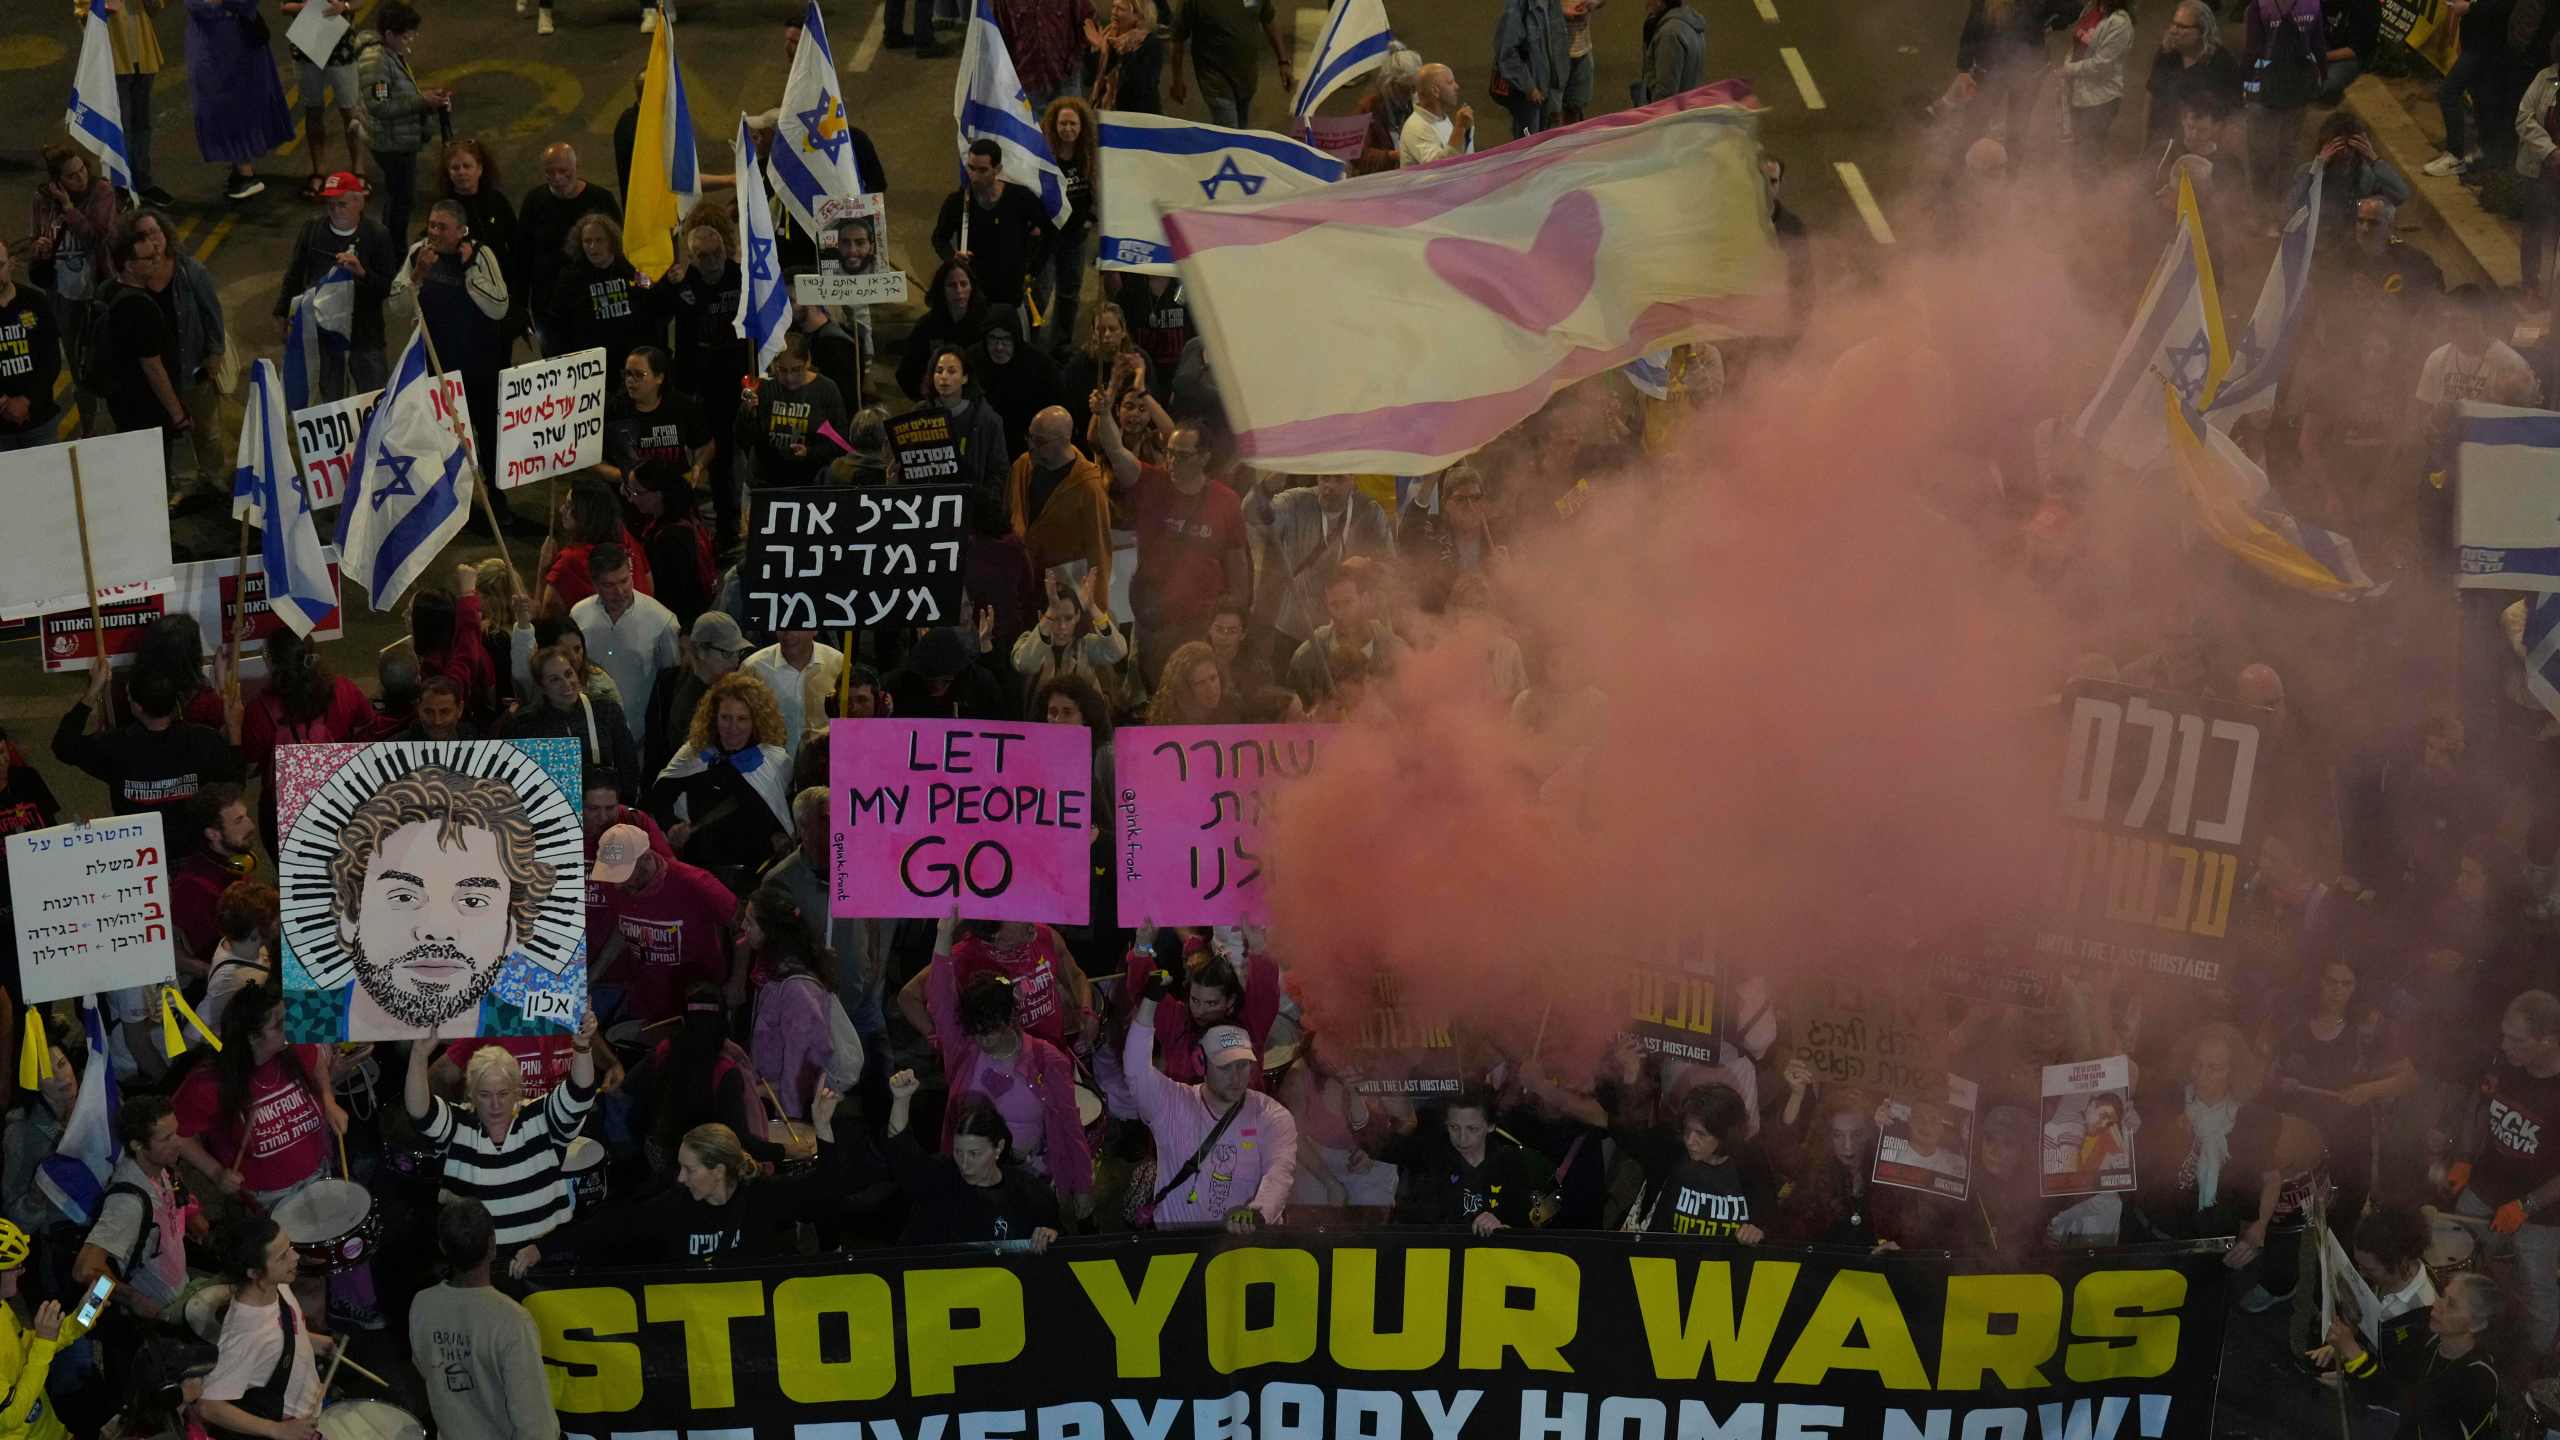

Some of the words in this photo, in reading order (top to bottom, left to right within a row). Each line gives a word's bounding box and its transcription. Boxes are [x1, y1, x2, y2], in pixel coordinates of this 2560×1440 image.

[0, 338, 30, 356] עדיי
[537, 369, 562, 394] יהיה
[568, 359, 604, 382] בסוף
[505, 377, 533, 401] טוב
[578, 391, 602, 413] אם
[772, 400, 788, 415] הם
[789, 402, 812, 418] למה
[532, 427, 567, 450] שזה
[573, 417, 602, 442] סימן
[896, 428, 949, 446] החטופים
[553, 445, 577, 467] לא
[901, 445, 956, 466] מסרבים
[508, 455, 546, 486] הסוף
[904, 461, 959, 481] למלחמה
[760, 502, 837, 535] את
[855, 494, 963, 534] תציל
[762, 541, 960, 579] המדינה
[749, 586, 942, 632] מעצמך
[908, 730, 1026, 774] LET
[1153, 738, 1317, 782] שחרר
[2064, 696, 2261, 846] כולם
[849, 784, 910, 827] MY
[928, 782, 1086, 829] PEOPLE
[27, 836, 51, 854] על
[63, 824, 144, 848] החטופים
[1119, 788, 1144, 883] @pink.front
[900, 835, 1013, 899] GO
[1191, 836, 1270, 901] לנו
[2065, 831, 2241, 939] עכשיו
[27, 921, 80, 943] בגידה
[32, 943, 88, 966] חידלון
[2149, 950, 2220, 981] HOSTAGE!
[526, 990, 570, 1019] אלון
[1628, 971, 1713, 1035] עכש
[1663, 1040, 1712, 1062] HOSTAGE!
[1382, 1079, 1399, 1092] THE
[1400, 1079, 1419, 1092] LAST
[1420, 1079, 1460, 1092] HOSTAGE!
[2490, 1098, 2541, 1145] FCK
[1675, 1185, 1750, 1222] בלעדיהם
[522, 1264, 1029, 1413] STOP
[1069, 1246, 1582, 1379] YOUR
[1628, 1255, 2191, 1391] WARS
[794, 1381, 1485, 1440] RYBODY
[1519, 1389, 1845, 1440] HOME
